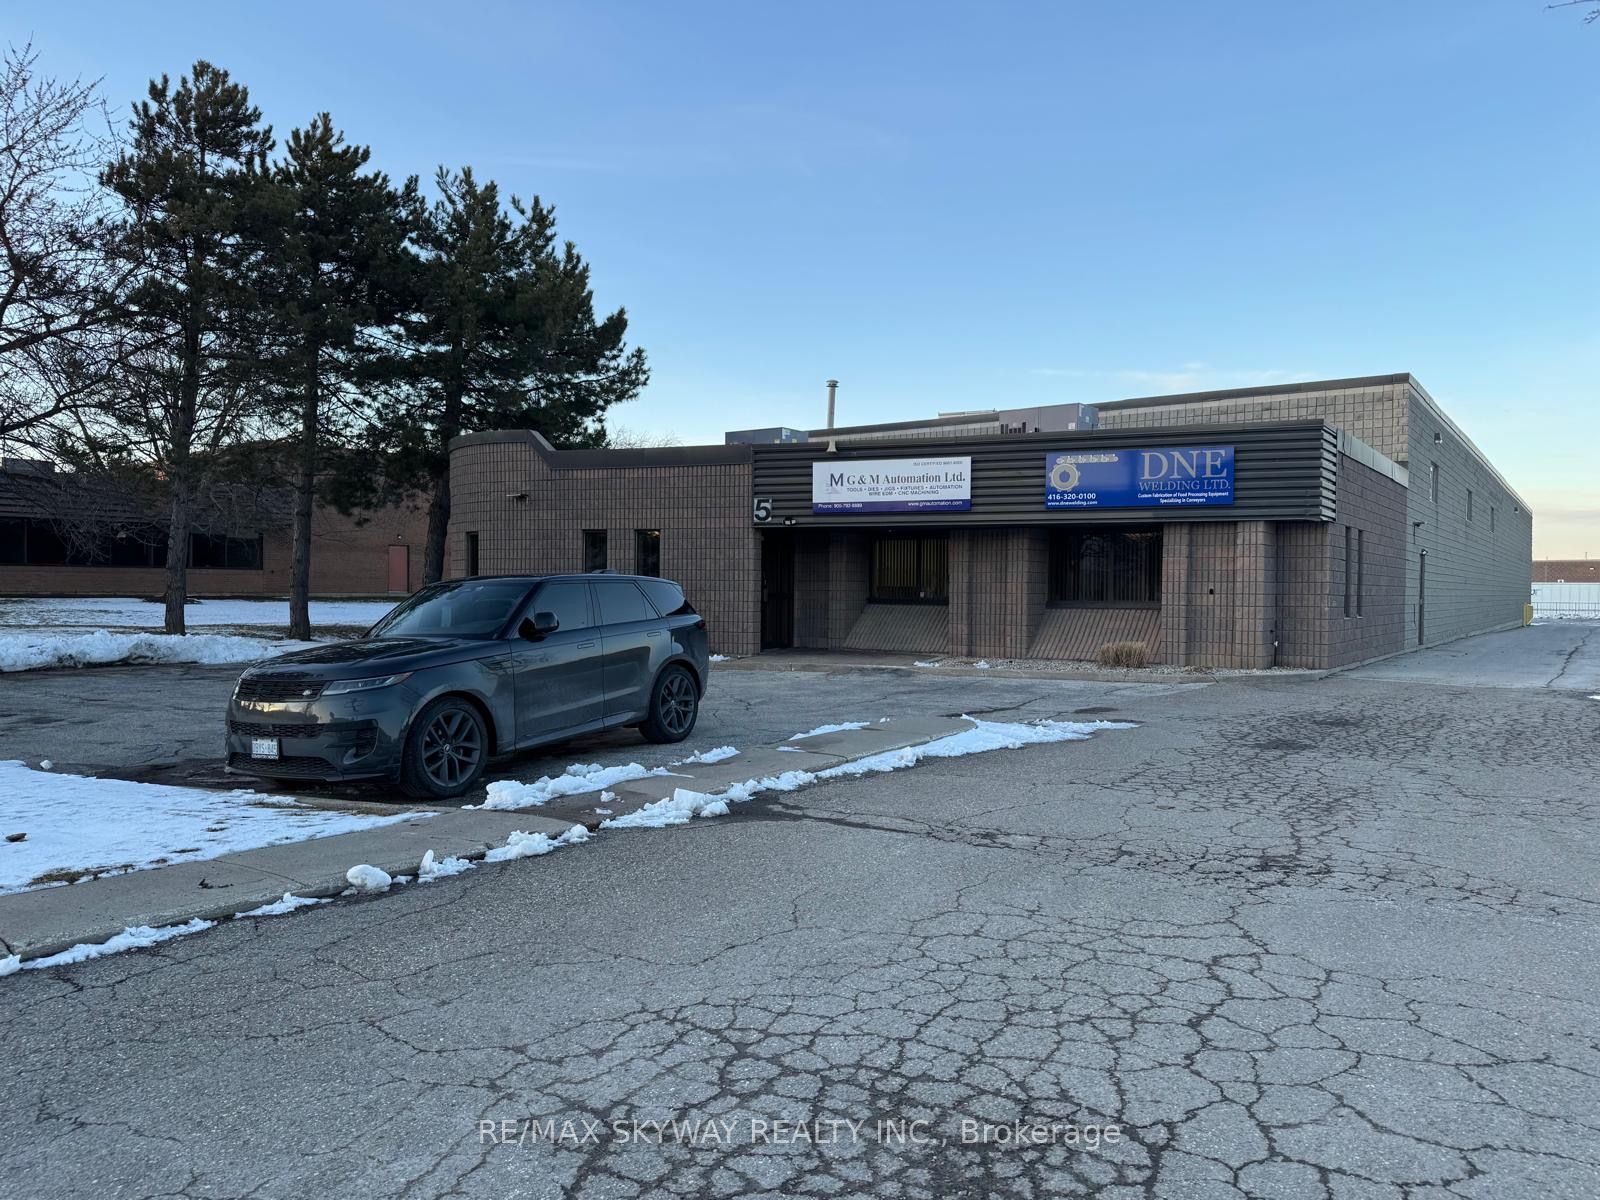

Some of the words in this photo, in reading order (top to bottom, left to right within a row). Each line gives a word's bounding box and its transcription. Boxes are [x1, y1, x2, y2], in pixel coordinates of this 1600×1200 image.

[1140, 449, 1228, 480] DNE
[830, 473, 844, 487] M
[846, 475, 856, 485] G
[857, 475, 867, 485] &
[869, 474, 880, 485] M
[882, 472, 941, 485] Automation
[944, 471, 966, 483] Ltd.
[1138, 480, 1200, 491] WELDING
[1203, 479, 1231, 490] LTD.
[754, 498, 771, 522] 5
